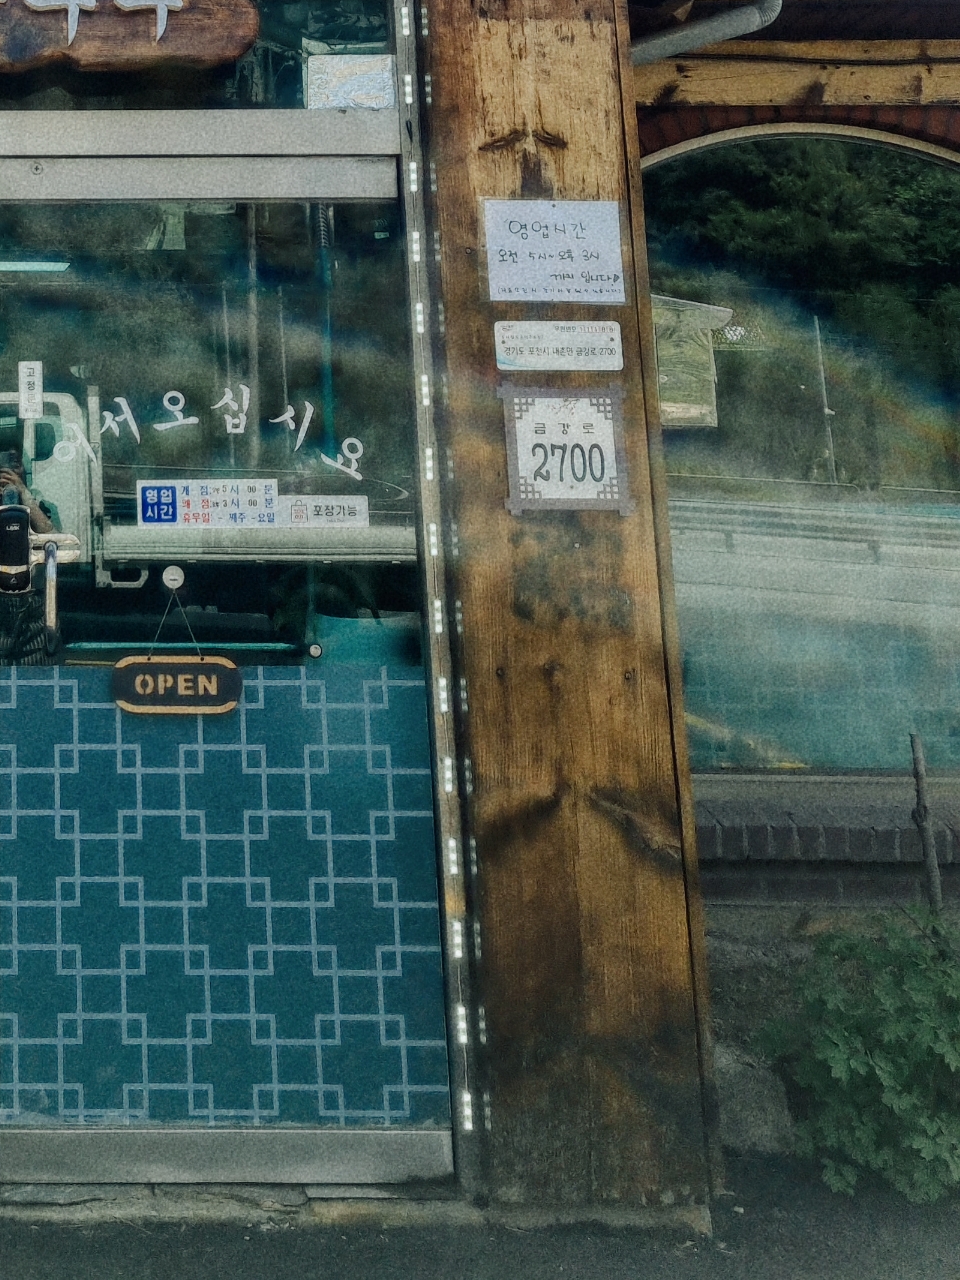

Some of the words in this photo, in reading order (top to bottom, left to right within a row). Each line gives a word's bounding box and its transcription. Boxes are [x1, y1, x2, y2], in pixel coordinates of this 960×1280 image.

[507, 220, 587, 241] 영업시간
[498, 249, 519, 264] 오전
[503, 346, 525, 356] 경기도
[528, 346, 550, 356] 포천시
[552, 346, 574, 356] 내촌면
[575, 346, 598, 356] 금강로
[599, 346, 617, 356] 2700
[533, 422, 595, 435] 금강로
[531, 442, 606, 483] 2700
[145, 489, 173, 504] 영업
[145, 504, 174, 520] 시간
[313, 504, 358, 517] 포장가능
[134, 673, 218, 696] OPEN
